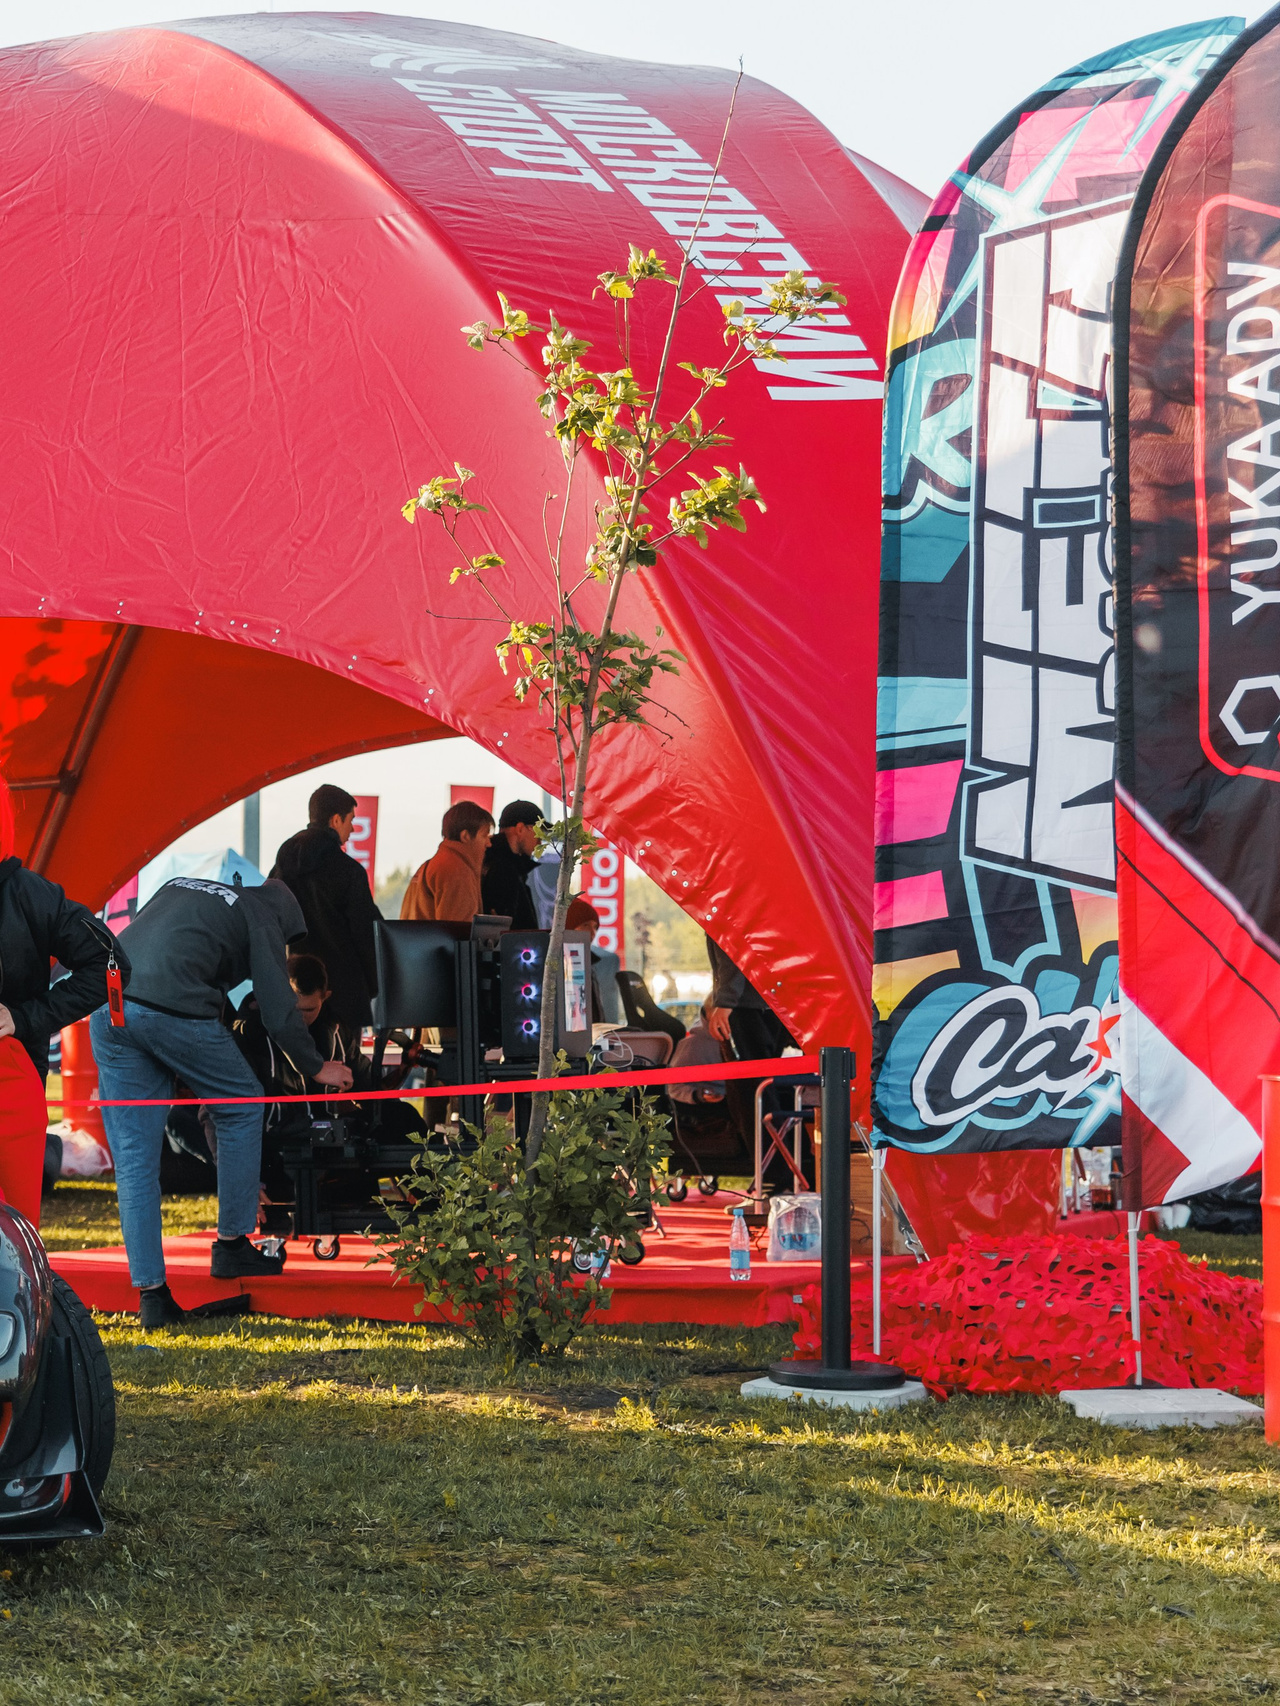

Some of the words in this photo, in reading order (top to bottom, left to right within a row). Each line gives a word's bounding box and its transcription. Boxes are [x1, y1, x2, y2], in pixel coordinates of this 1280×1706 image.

[393, 77, 614, 192] СПОРТ
[1227, 262, 1280, 406] ADV
[1227, 420, 1280, 626] YUKA
